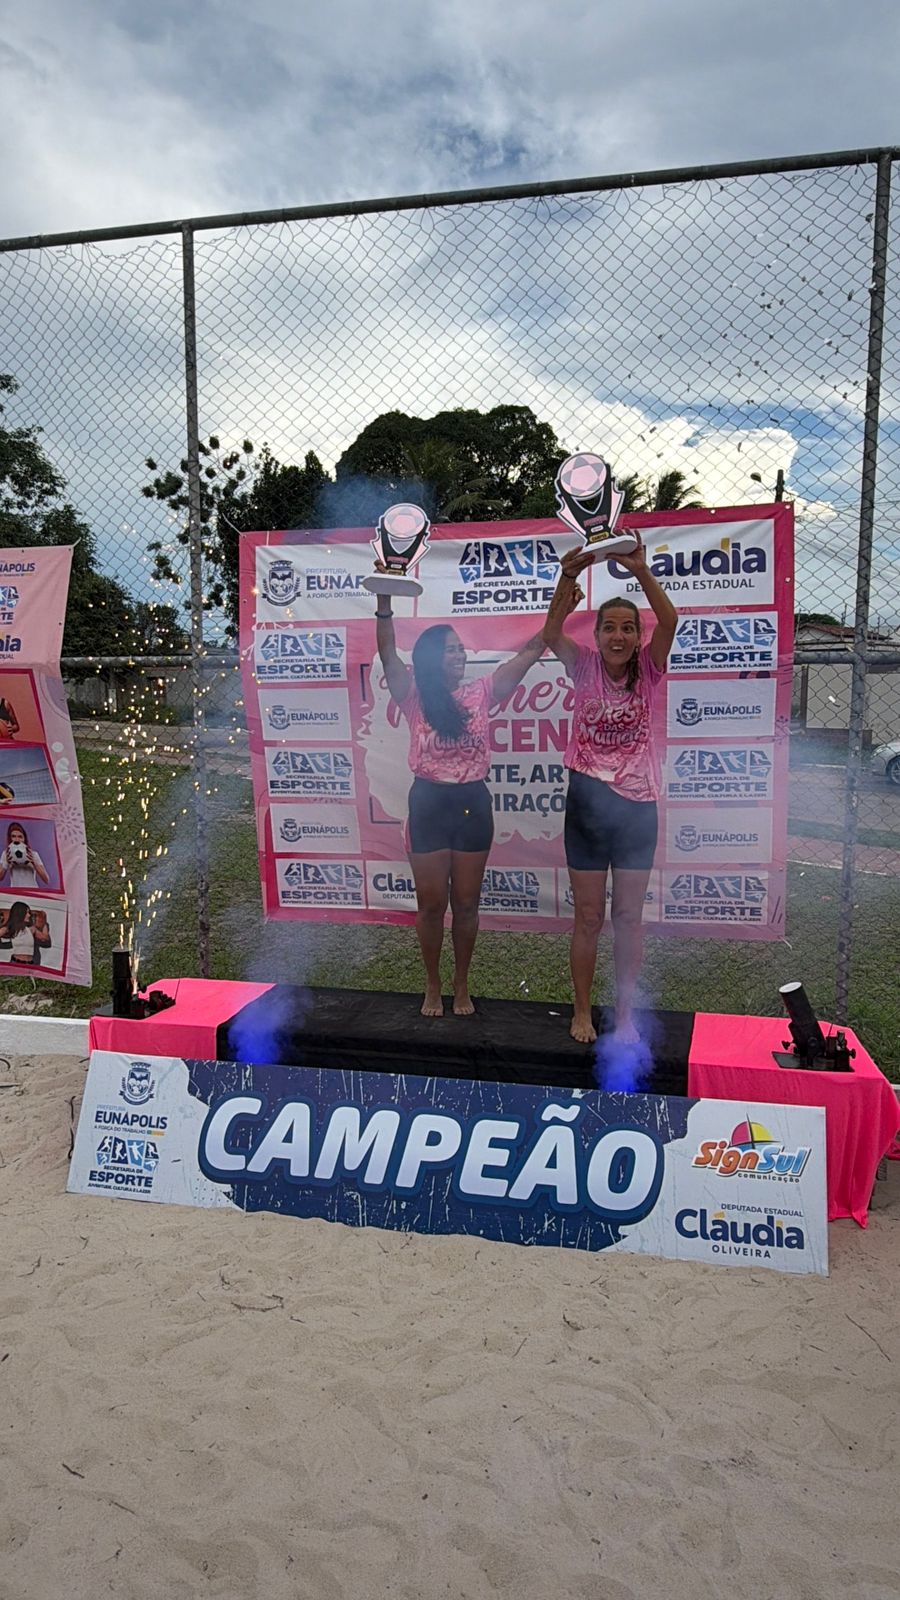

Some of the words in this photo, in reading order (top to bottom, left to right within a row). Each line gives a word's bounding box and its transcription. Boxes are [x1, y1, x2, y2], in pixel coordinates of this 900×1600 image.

[473, 579, 525, 588] SECRETARIA
[626, 582, 689, 592] DETADA
[693, 578, 755, 590] ESTADUAL
[452, 587, 555, 605] ESPORTE
[670, 651, 772, 664] ESPORTE
[256, 663, 342, 674] ESPORTE
[291, 711, 339, 721] EUNÁPOLIS
[704, 704, 761, 716] EUNÁPOLIS
[604, 723, 625, 731] DAS
[488, 719, 568, 752] CEN
[270, 780, 351, 790] ESPORTE
[668, 782, 767, 792] ESPORTE
[494, 787, 566, 817] IRAÇÕ
[302, 825, 349, 834] EUNÁPOLIS
[702, 832, 758, 842] EUNÁPOLIS
[281, 891, 362, 900] ESPORTE
[664, 905, 762, 916] ESPORTE
[94, 1110, 168, 1129] EUNÁPOLIS
[205, 1096, 658, 1211] CAMPEÃO
[692, 1140, 811, 1177] SignSul
[104, 1165, 135, 1173] SECRETARIA
[89, 1170, 153, 1188] ESPORTE
[738, 1172, 800, 1183] comunicação
[721, 1203, 762, 1214] DEPUTADA
[764, 1207, 804, 1217] ESTADUAL
[675, 1208, 804, 1249] Cláudia
[712, 1244, 771, 1259] OLIVEIRA
